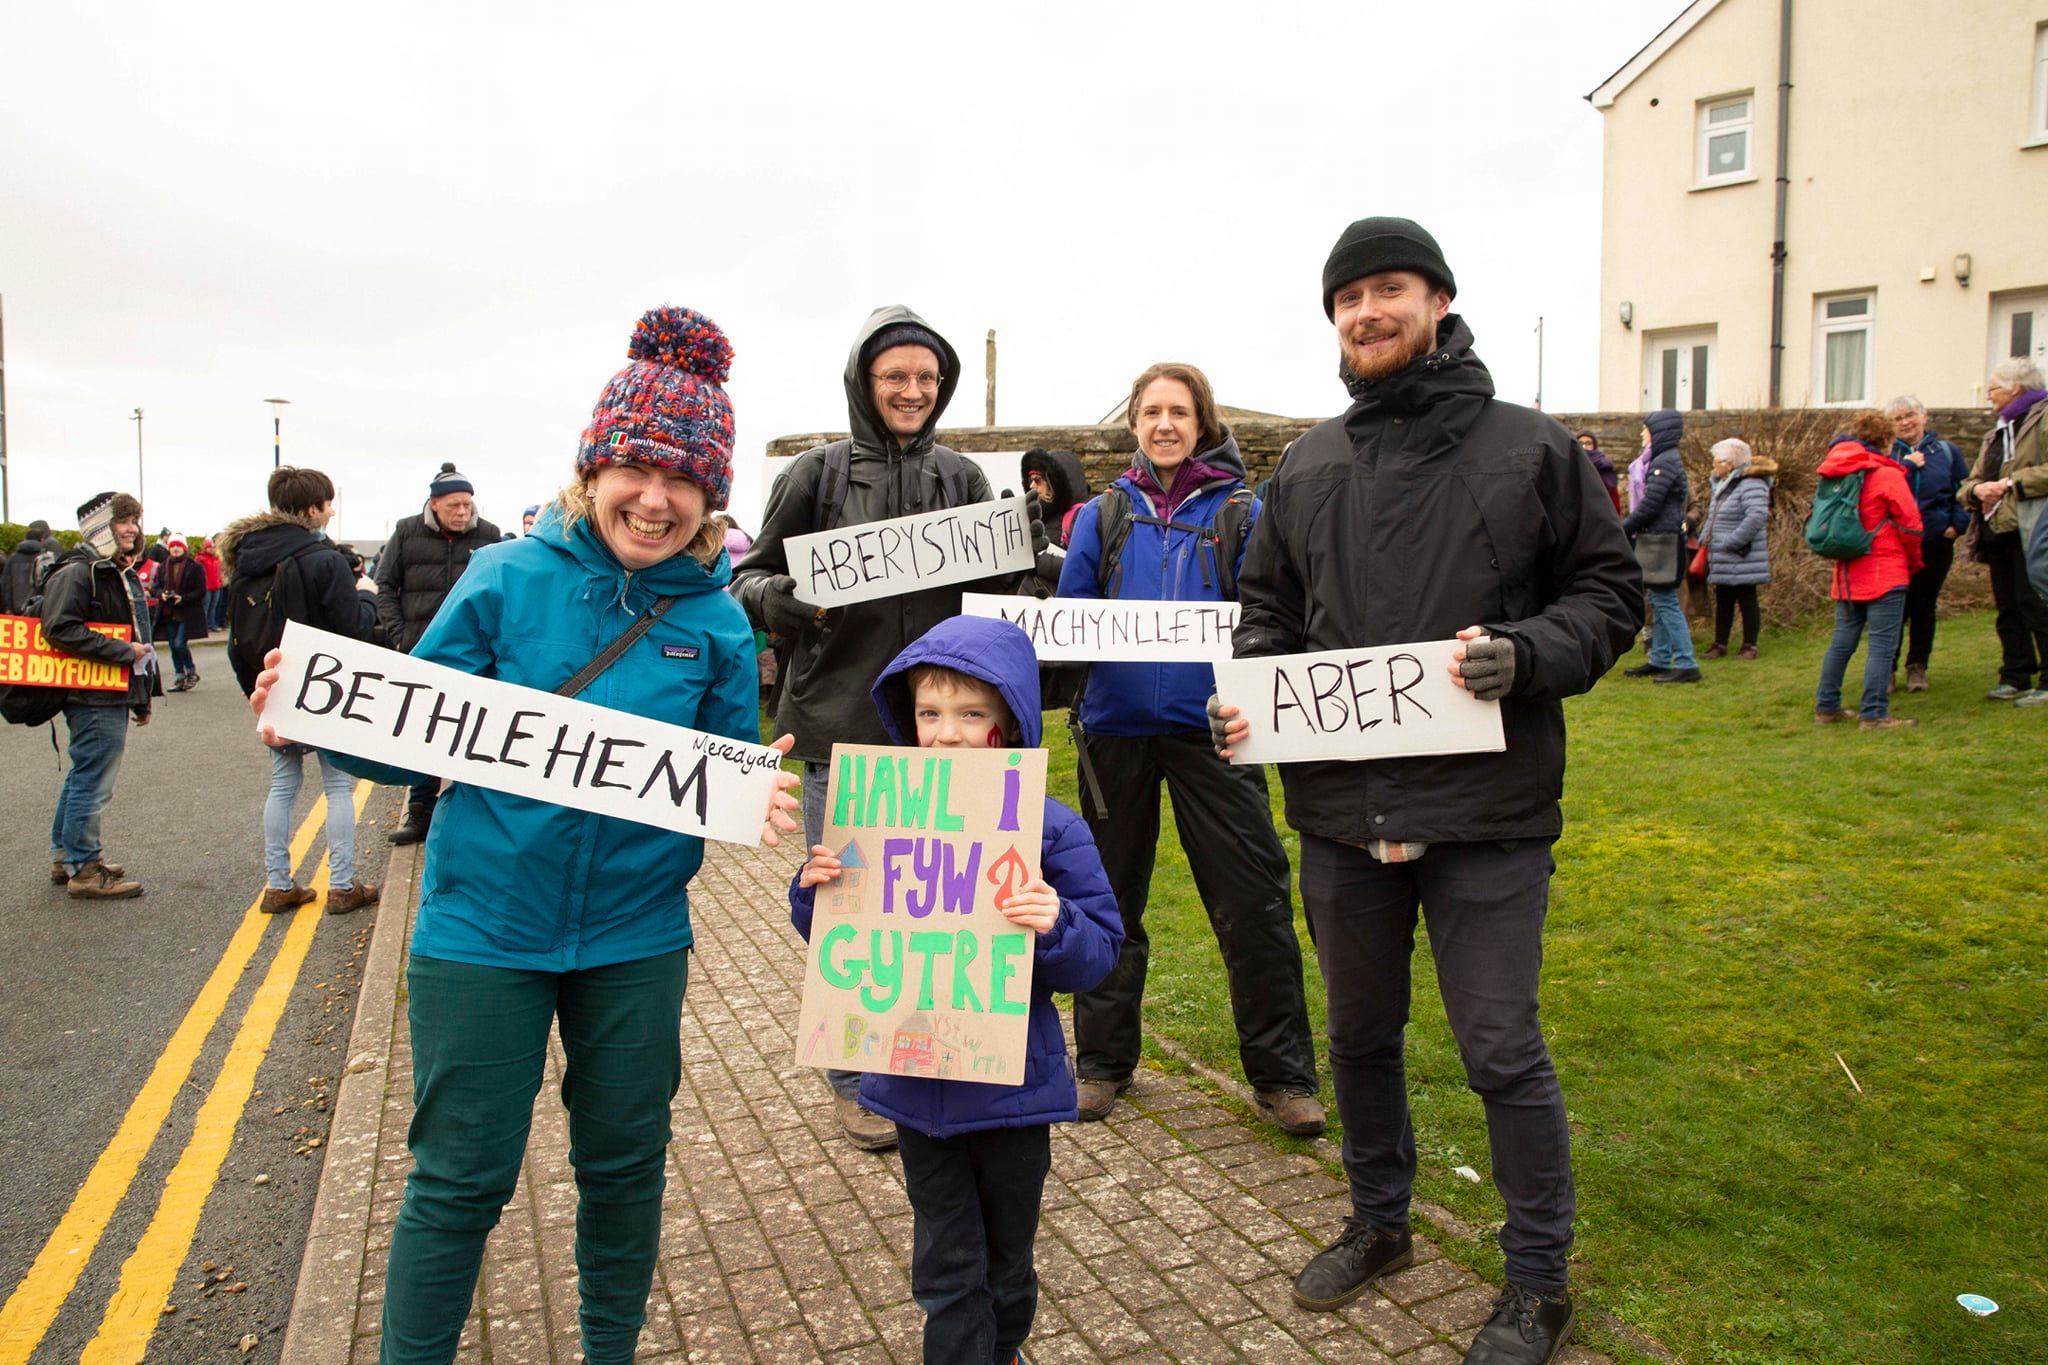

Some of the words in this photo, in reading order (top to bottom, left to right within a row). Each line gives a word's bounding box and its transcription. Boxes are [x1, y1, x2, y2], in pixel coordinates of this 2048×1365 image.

[809, 509, 1024, 594] ABERYSTWYTH
[1273, 653, 1432, 734] ABER
[295, 652, 707, 826] BETHLEHEM
[692, 735, 780, 775] Meredydd
[833, 754, 965, 832] HAWL
[818, 923, 1028, 1016] GYTRE
